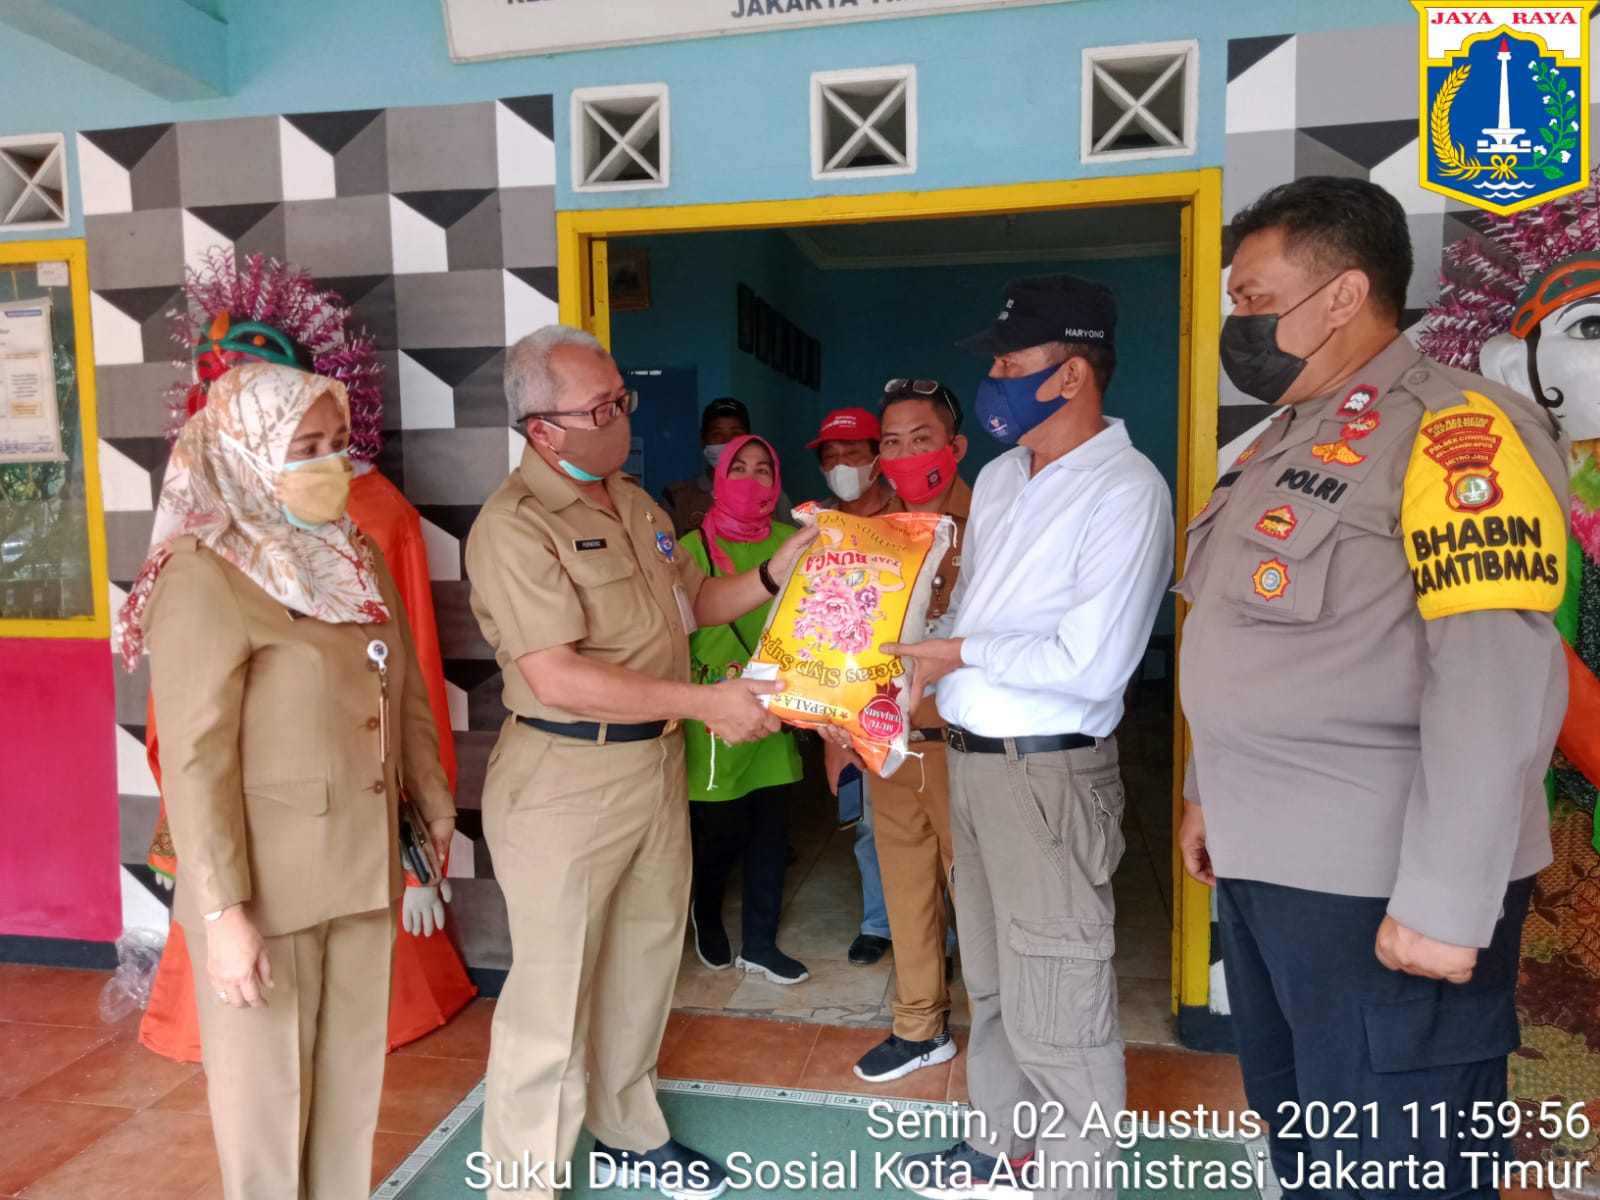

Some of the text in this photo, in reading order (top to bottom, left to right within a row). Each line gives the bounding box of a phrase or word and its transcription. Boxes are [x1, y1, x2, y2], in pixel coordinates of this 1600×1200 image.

[1065, 328, 1104, 339] HARYONO
[1275, 468, 1348, 504] POLRI
[1411, 516, 1542, 561] BHABIN
[805, 550, 899, 572] TJAP BUNGA
[1411, 549, 1559, 599] KAMTIBMAS
[796, 659, 840, 687] Slyp
[846, 657, 905, 682] Beras
[784, 695, 837, 717] KEPALA
[870, 718, 895, 732] MUTU
